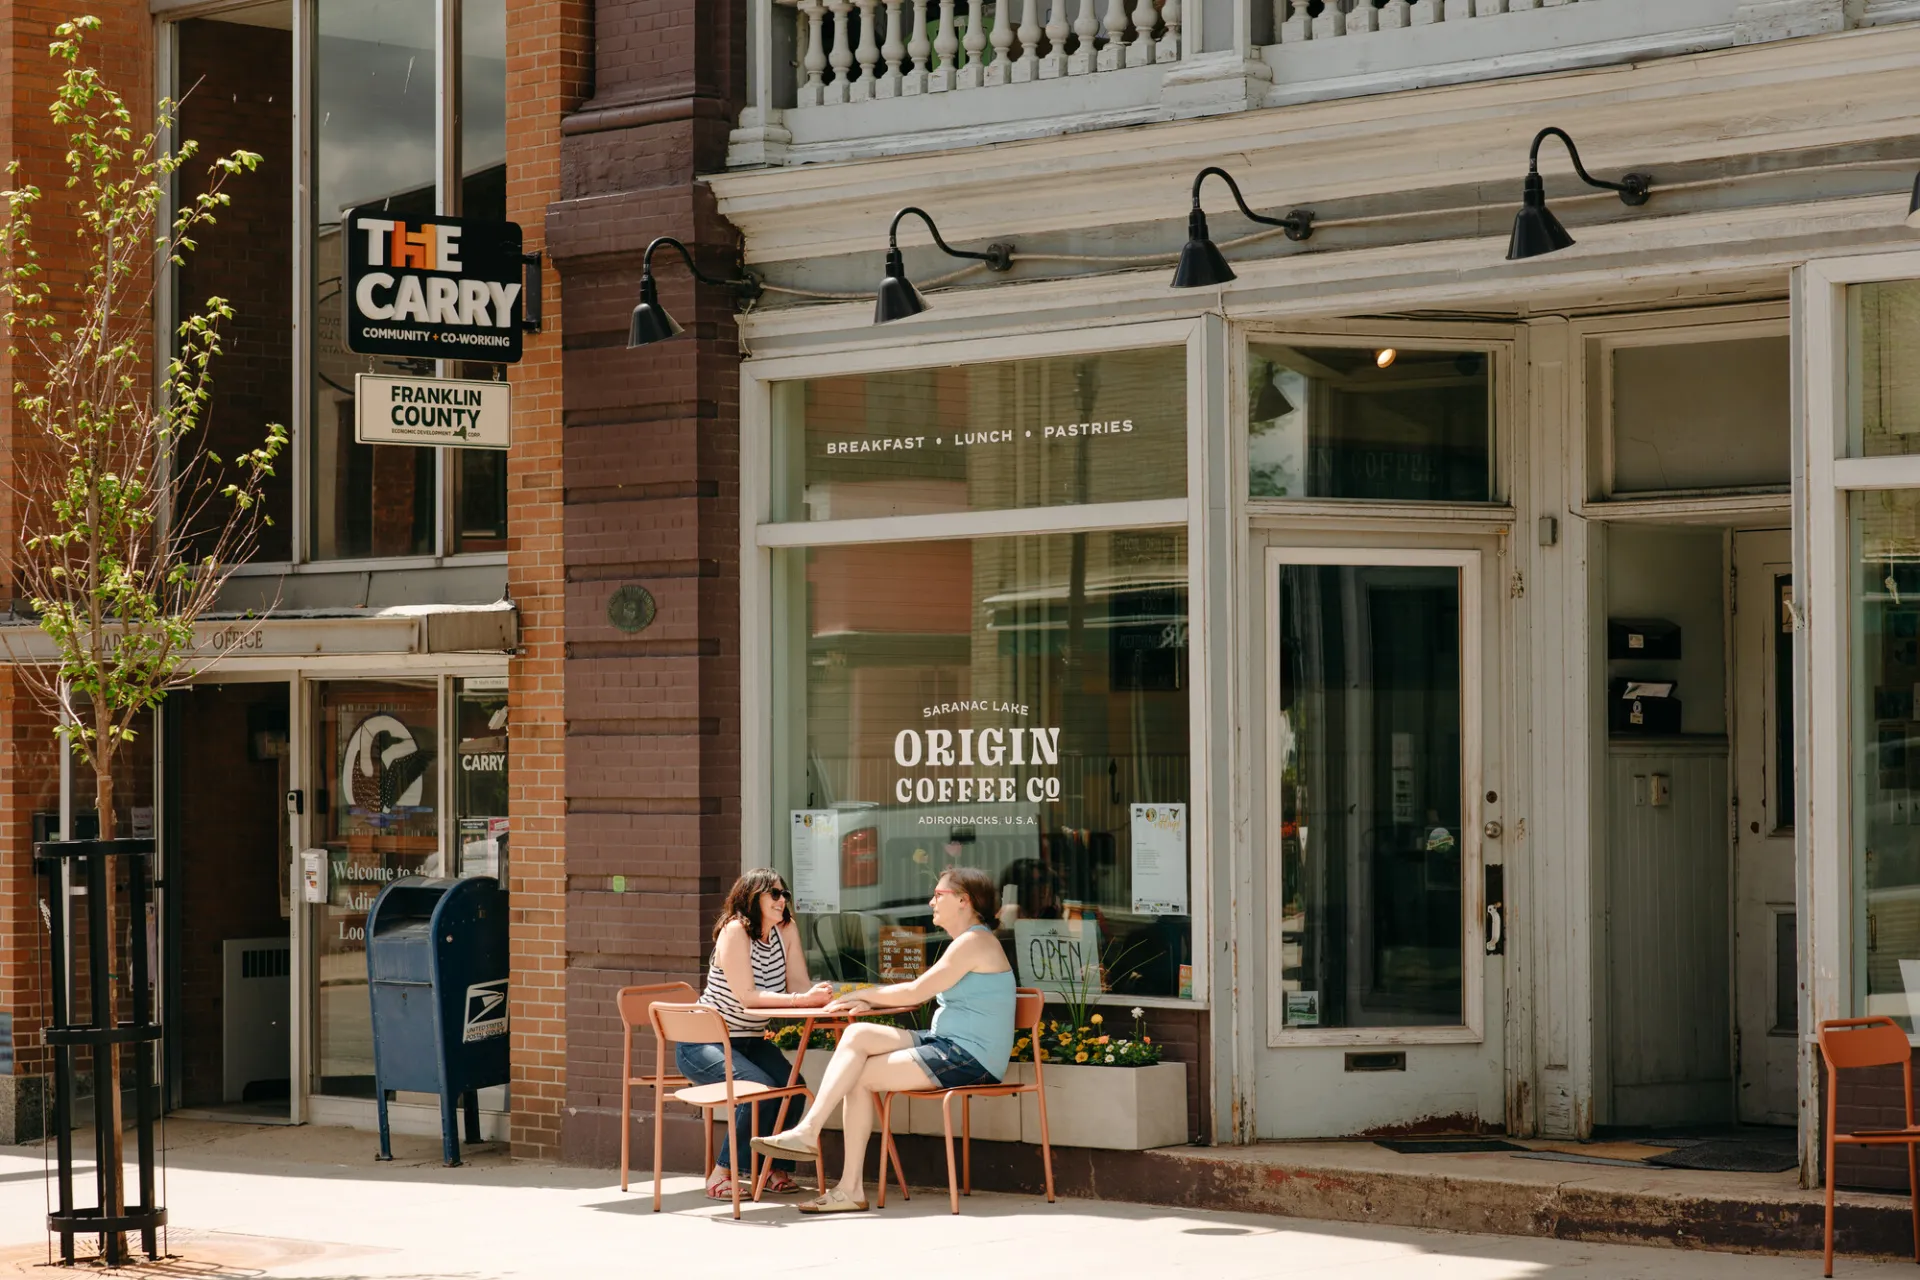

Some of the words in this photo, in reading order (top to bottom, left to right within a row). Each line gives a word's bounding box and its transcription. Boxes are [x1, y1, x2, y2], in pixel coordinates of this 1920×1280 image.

[357, 218, 462, 272] THE
[356, 272, 522, 328] CARRY
[363, 327, 430, 342] COMMUNITY
[441, 333, 510, 347] CO-WORKING
[391, 385, 482, 406] FRANKLIN
[391, 405, 481, 428] COUNTY
[827, 436, 925, 454] BREAKFAST
[954, 429, 1012, 446] LUNCH
[1044, 419, 1133, 438] PASTRIES
[212, 630, 263, 650] OFFICE
[923, 700, 988, 718] SARANAC
[992, 701, 1029, 716] LAKE
[894, 727, 1060, 767] ORIGIN
[462, 754, 505, 771] CARRY
[895, 777, 1016, 803] COFFEE
[918, 816, 1001, 826] ADIRONDACKS,
[1005, 816, 1038, 825] U.S.A.
[332, 860, 393, 881] Welcome
[338, 921, 366, 940] Loo
[1029, 938, 1084, 981] OPEN
[466, 1024, 485, 1034] UNITED
